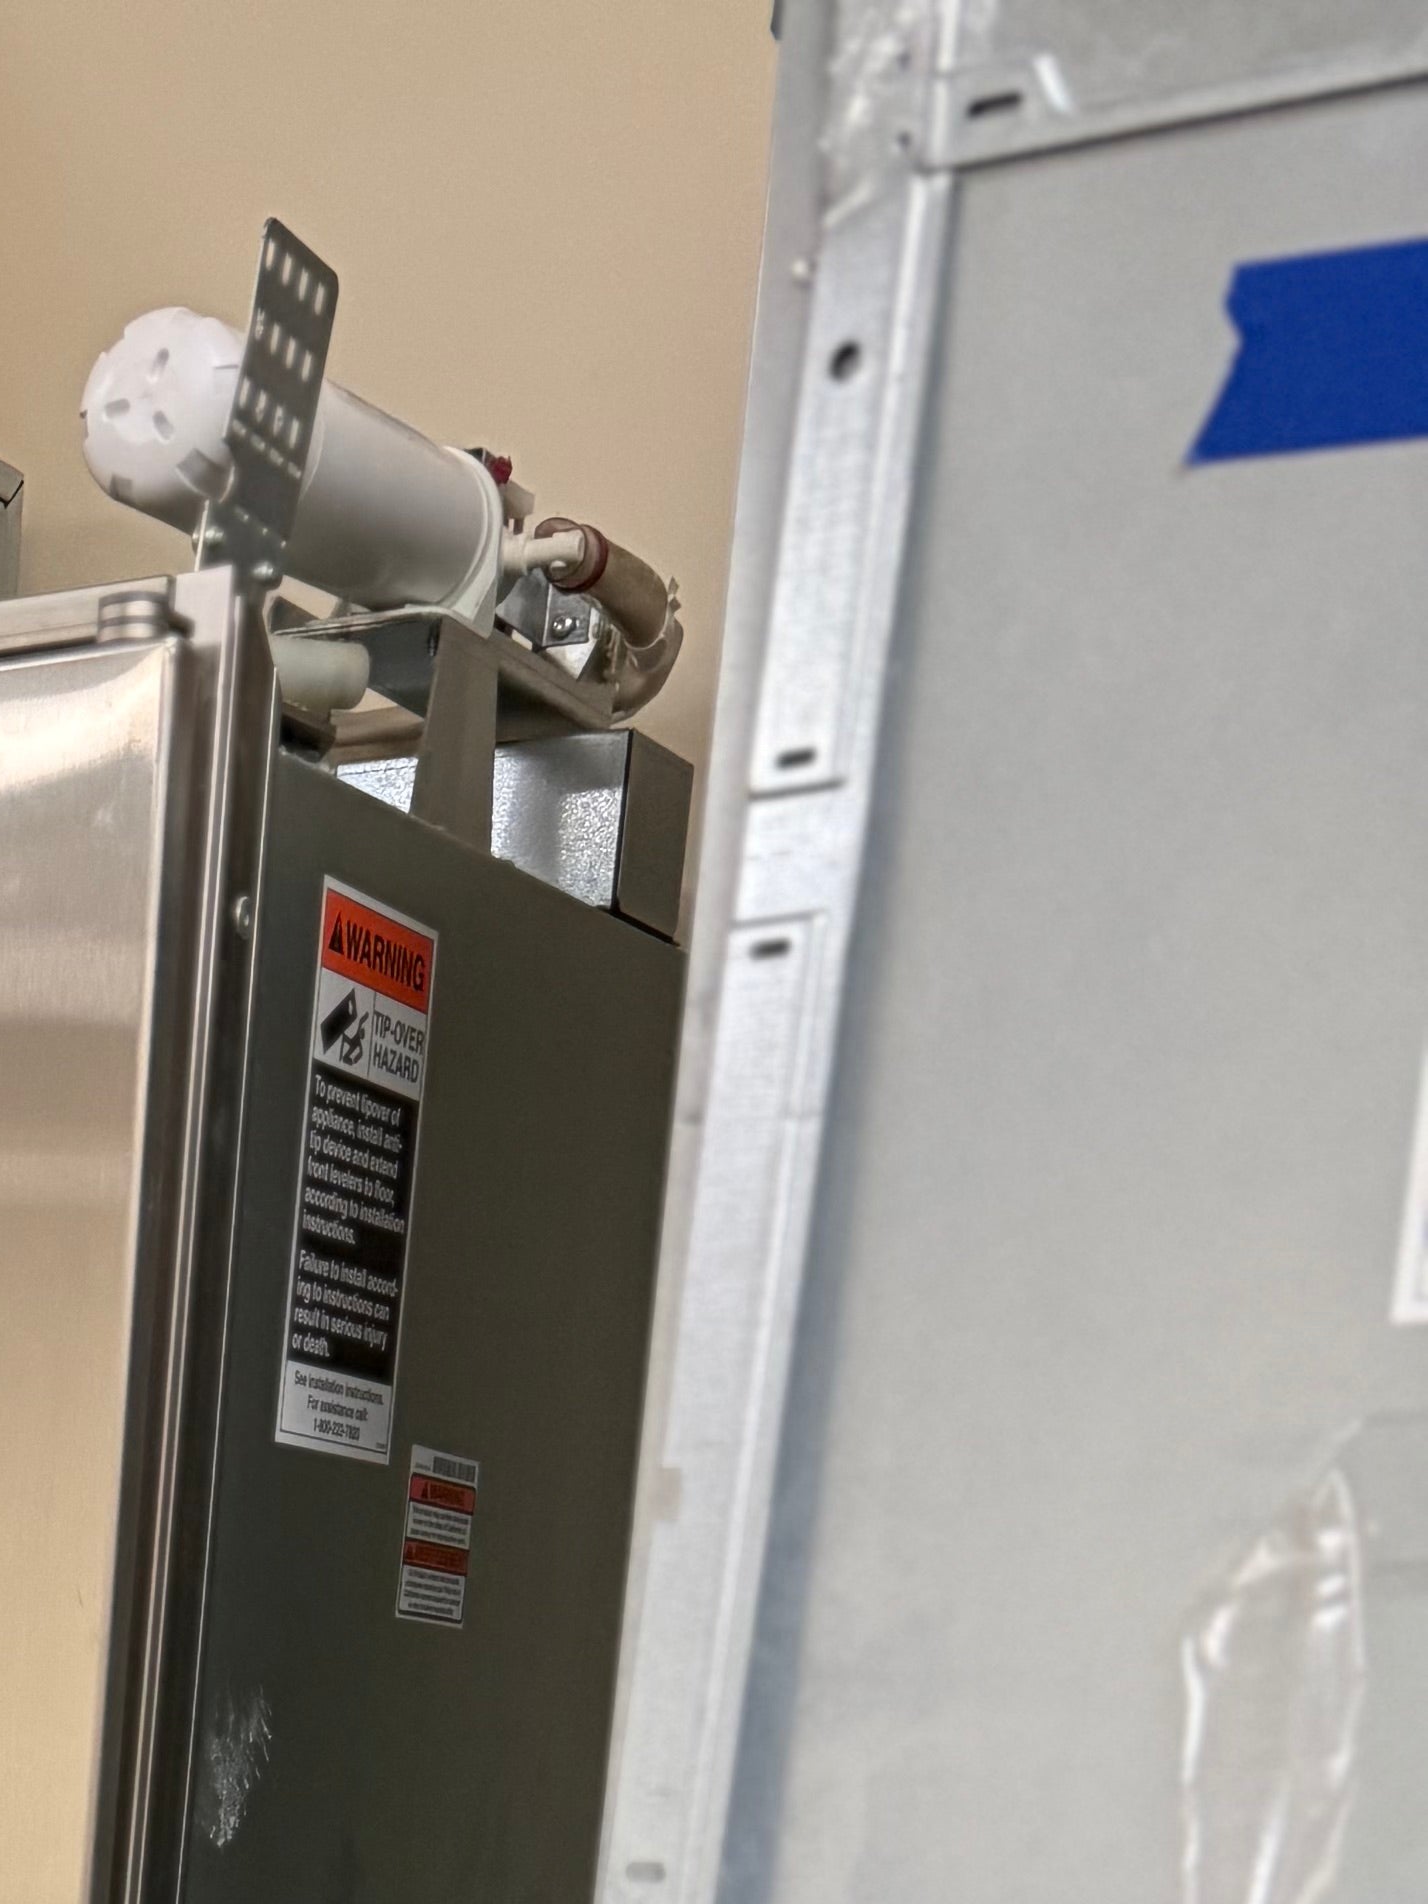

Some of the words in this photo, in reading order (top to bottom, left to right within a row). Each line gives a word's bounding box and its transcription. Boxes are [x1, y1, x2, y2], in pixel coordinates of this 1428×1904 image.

[345, 920, 426, 992] WARNING
[373, 1011, 425, 1055] TIP-OVER
[373, 1043, 420, 1083] HAZARD
[316, 1075, 326, 1097] To
[326, 1084, 360, 1111] prevent
[391, 1108, 401, 1126] of
[312, 1106, 355, 1139] appliance,
[357, 1119, 383, 1146] install
[308, 1156, 329, 1181] front
[330, 1164, 362, 1193] levelers
[364, 1177, 373, 1197] to
[310, 1130, 321, 1154] tip
[323, 1134, 352, 1162] device
[352, 1150, 369, 1168] and
[370, 1155, 398, 1179] extend
[303, 1209, 356, 1244] instructions.
[305, 1186, 348, 1220] according
[349, 1199, 358, 1218] to
[359, 1206, 405, 1234] installation
[299, 1250, 329, 1277] Failure
[330, 1260, 339, 1280] to
[340, 1262, 367, 1288] install
[297, 1276, 310, 1303] ing
[312, 1282, 322, 1301] to
[324, 1284, 373, 1316] instructions
[374, 1304, 389, 1320] can
[292, 1333, 302, 1349] or
[304, 1332, 330, 1357] death.
[294, 1307, 319, 1328] result
[321, 1309, 329, 1330] in
[331, 1316, 362, 1339] serious
[364, 1323, 388, 1351] injury
